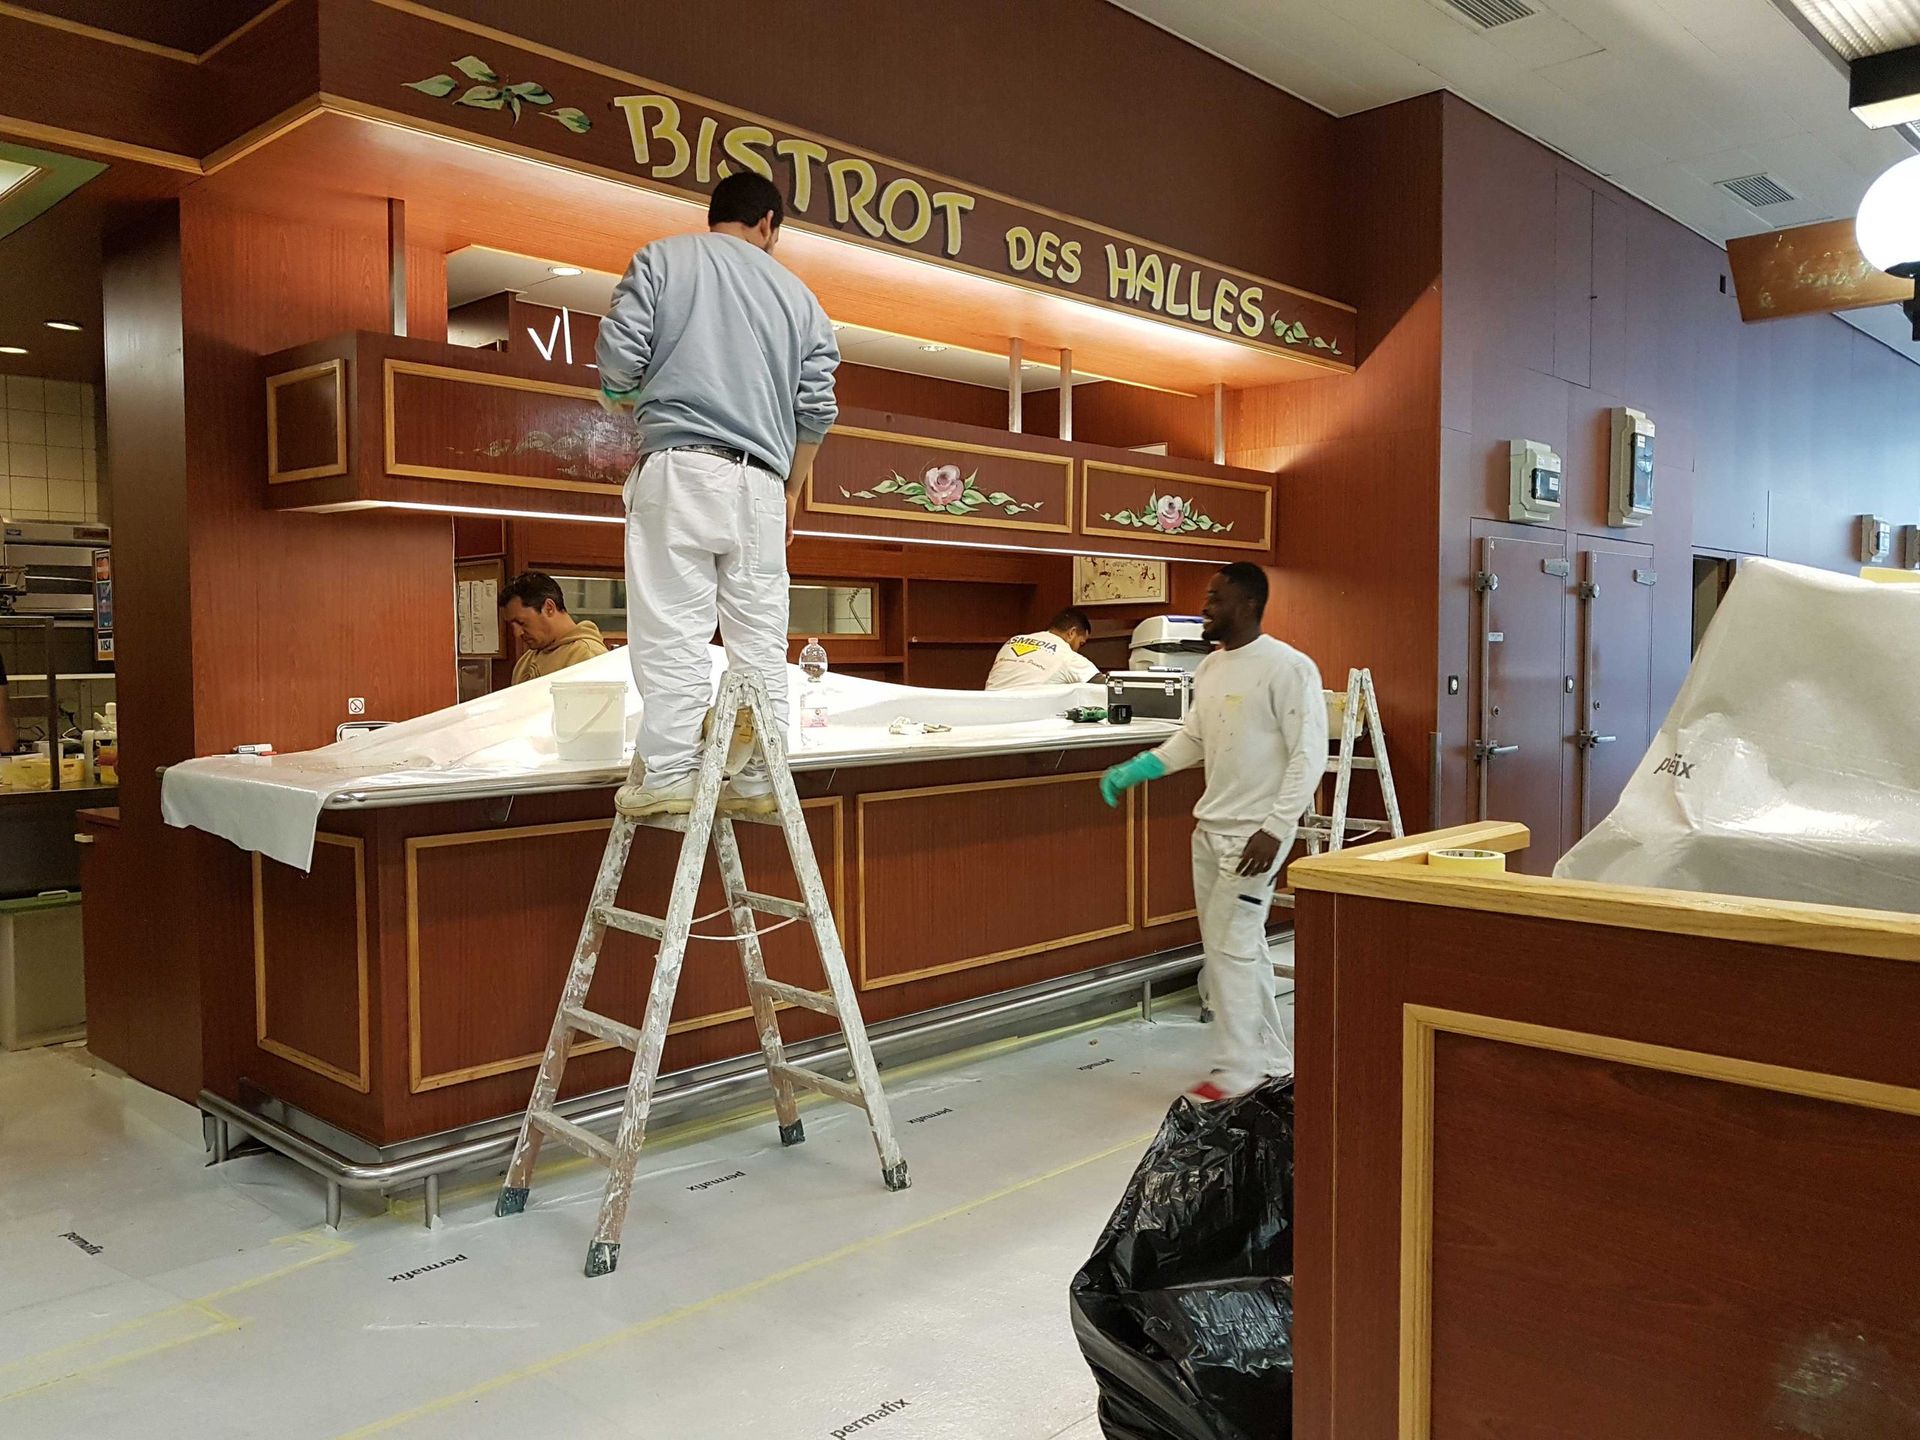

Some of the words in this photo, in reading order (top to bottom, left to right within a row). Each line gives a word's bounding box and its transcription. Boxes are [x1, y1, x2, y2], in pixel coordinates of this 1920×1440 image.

[614, 95, 976, 256] BISTROT
[1005, 226, 1082, 284] DES
[1104, 243, 1265, 337] HALLES
[686, 1170, 746, 1191] permafix
[387, 1253, 469, 1282] permafix
[829, 1398, 912, 1440] permafix
